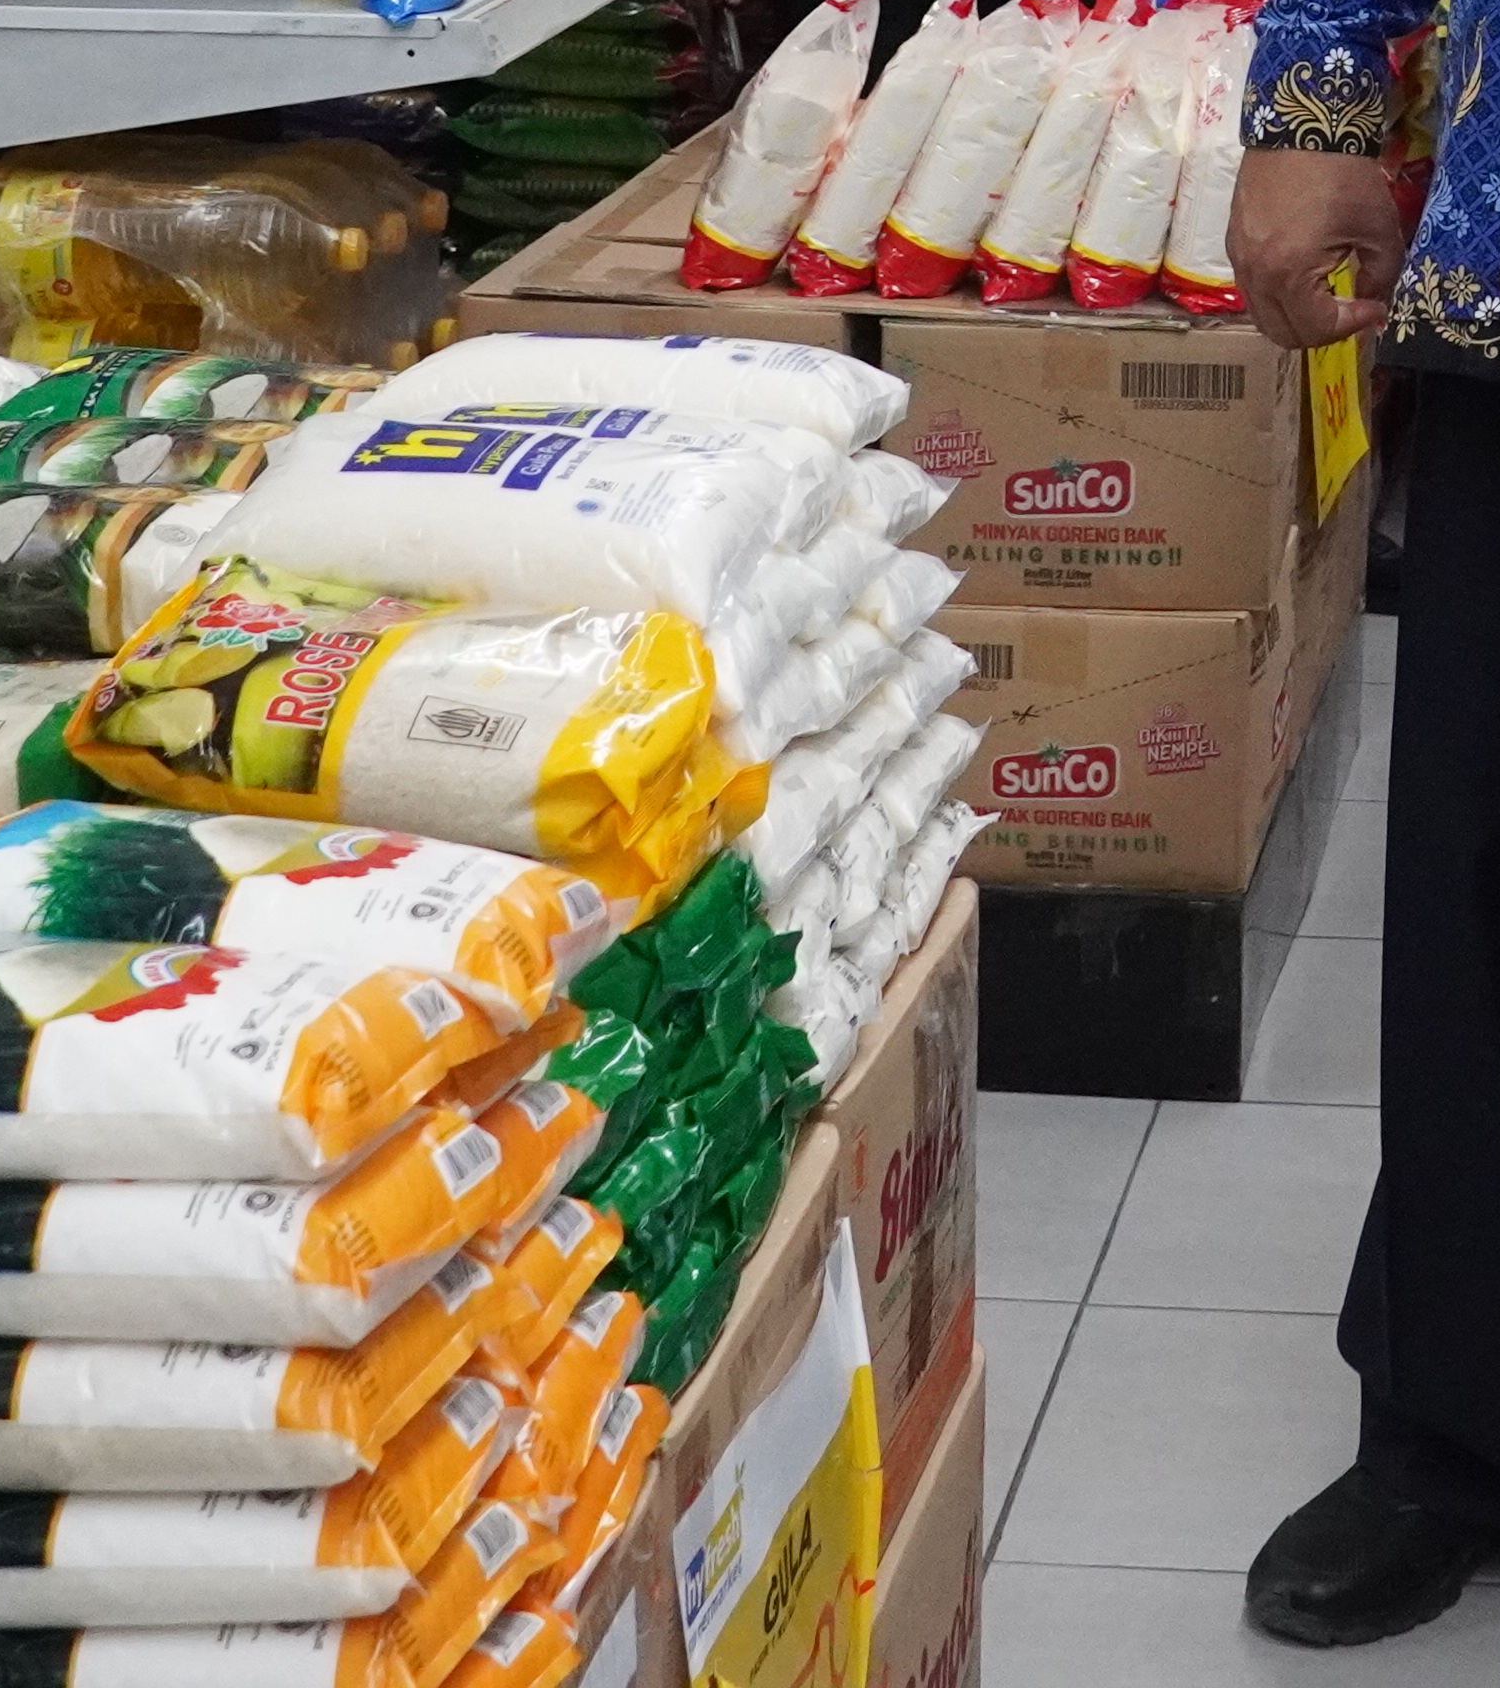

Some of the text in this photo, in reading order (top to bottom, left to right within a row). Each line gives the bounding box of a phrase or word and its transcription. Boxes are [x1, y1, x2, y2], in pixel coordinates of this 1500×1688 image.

[921, 445, 997, 470] NEMPEL
[1012, 467, 1124, 511] SunCo
[972, 523, 1168, 544] MINYAK GORENG BAIK
[946, 544, 1046, 563] PALING
[265, 630, 376, 729] ROSE
[1146, 740, 1222, 763] NEMPEL
[999, 753, 1110, 794] SunCo
[1033, 809, 1153, 829] GORENG BAIK
[763, 1506, 813, 1635] GULA
